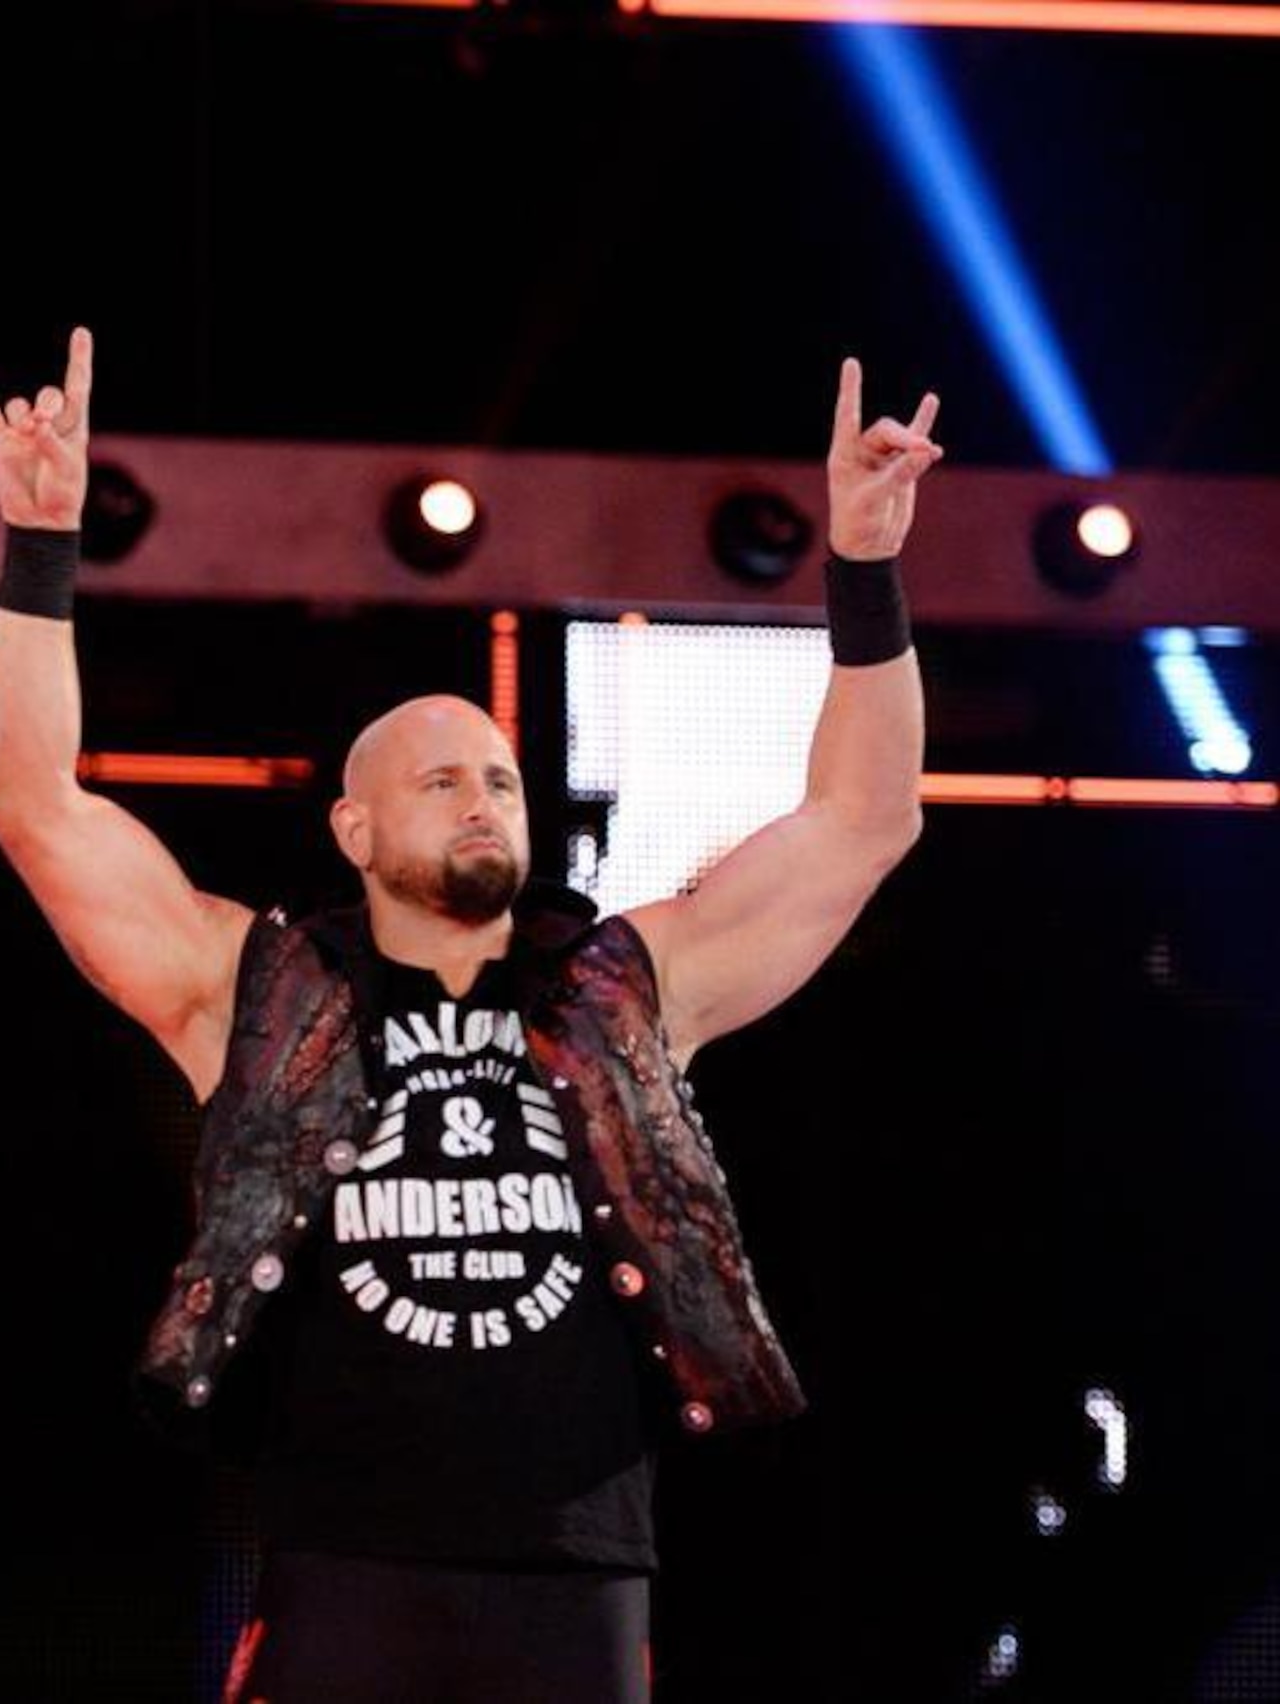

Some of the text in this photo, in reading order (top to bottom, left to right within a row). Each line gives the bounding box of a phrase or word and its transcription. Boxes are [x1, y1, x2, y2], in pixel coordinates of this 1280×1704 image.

[408, 1249, 526, 1280] THE CLUB
[339, 1253, 583, 1349] NO ONE IS SAFE
